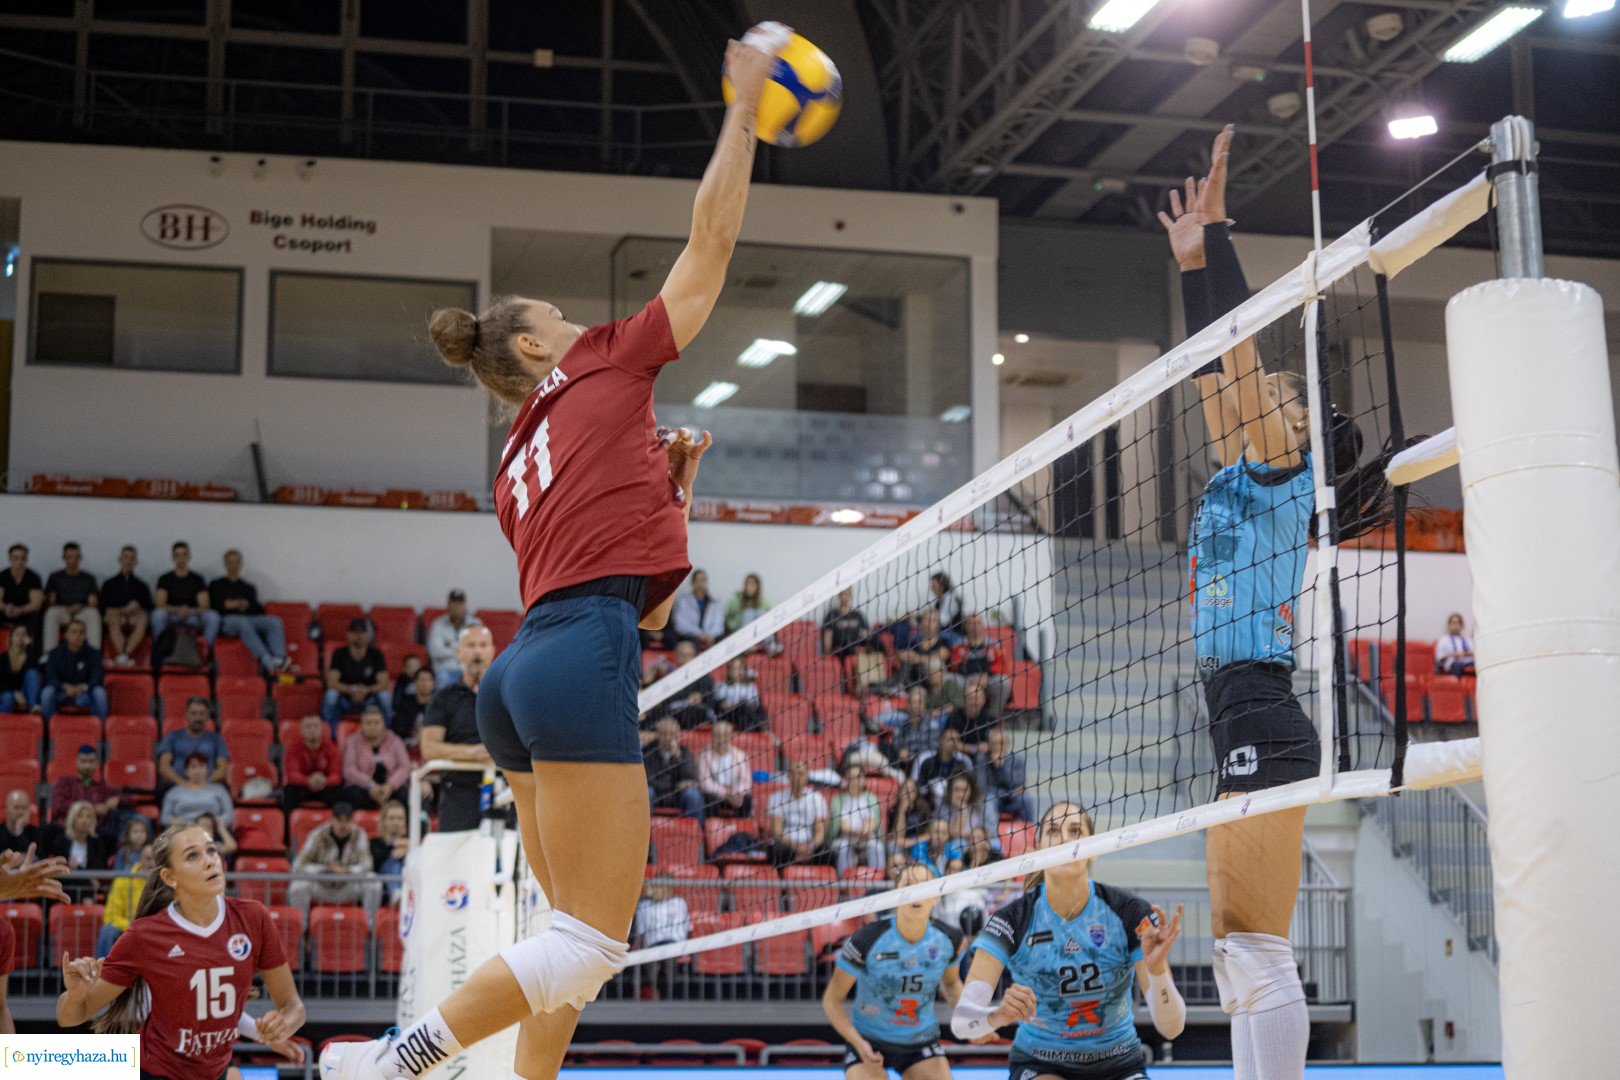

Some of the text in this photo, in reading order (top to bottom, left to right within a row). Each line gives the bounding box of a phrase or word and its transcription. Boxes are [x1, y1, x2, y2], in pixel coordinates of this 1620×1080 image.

[159, 213, 210, 242] BH
[250, 210, 377, 234] Bige Holding
[272, 234, 352, 254] Csoport
[189, 965, 237, 1021] 15
[901, 973, 924, 993] 15
[1058, 963, 1104, 997] 22
